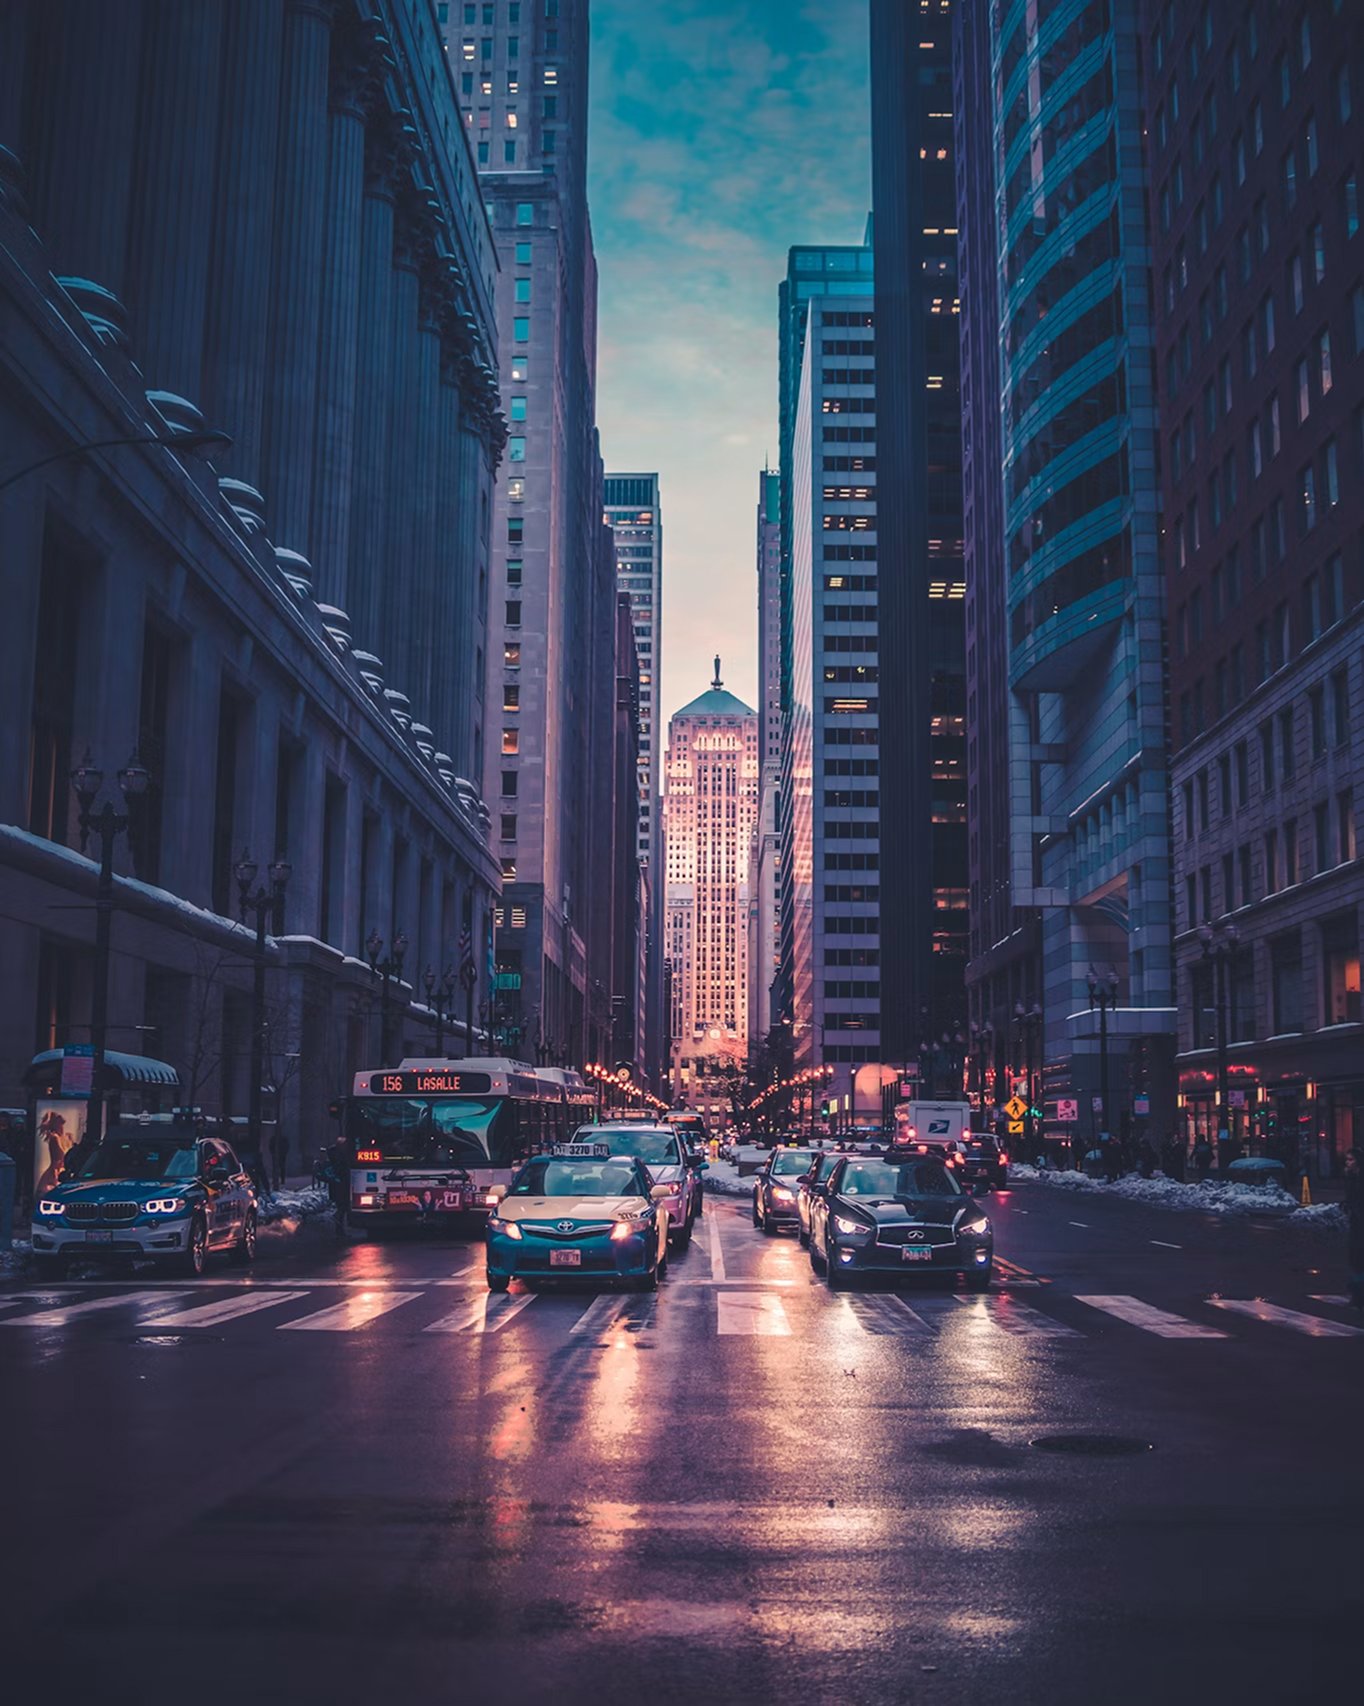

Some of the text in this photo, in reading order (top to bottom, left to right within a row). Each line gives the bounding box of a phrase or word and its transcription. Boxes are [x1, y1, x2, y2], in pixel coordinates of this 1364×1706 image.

[382, 1076, 461, 1092] 156 LASALLE
[569, 1145, 590, 1155] 3270
[357, 1151, 380, 1161] K915
